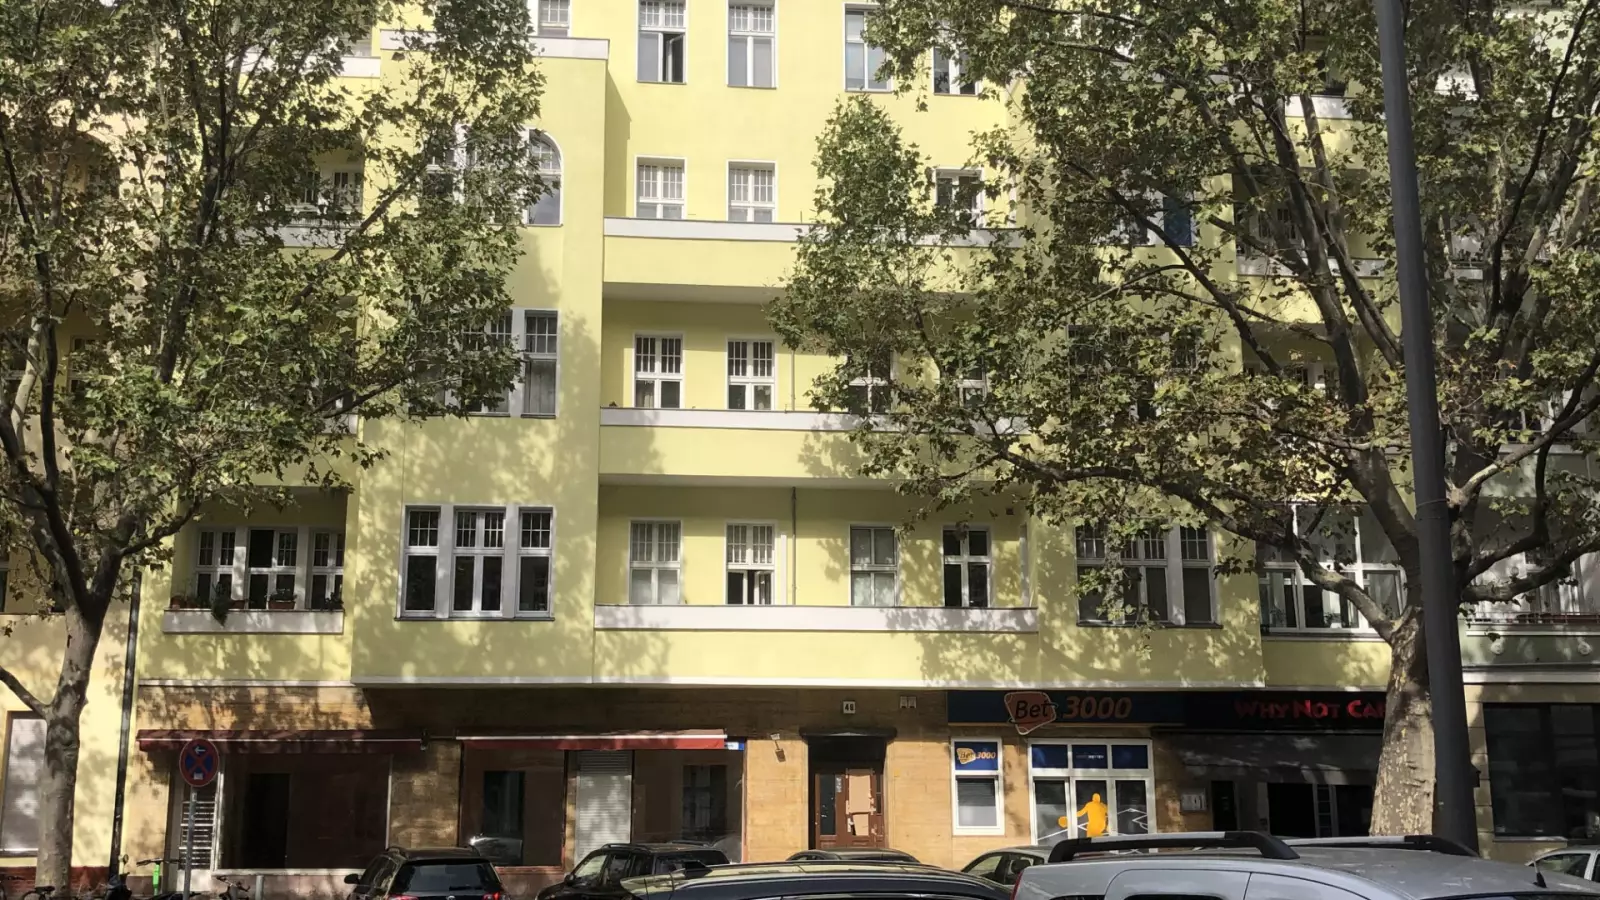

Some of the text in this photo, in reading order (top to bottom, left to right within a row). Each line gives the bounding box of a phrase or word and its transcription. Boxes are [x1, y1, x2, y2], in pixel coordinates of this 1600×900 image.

[1015, 696, 1132, 719] Bet 3000
[1293, 699, 1340, 719] NOT
[976, 751, 996, 759] 3000
